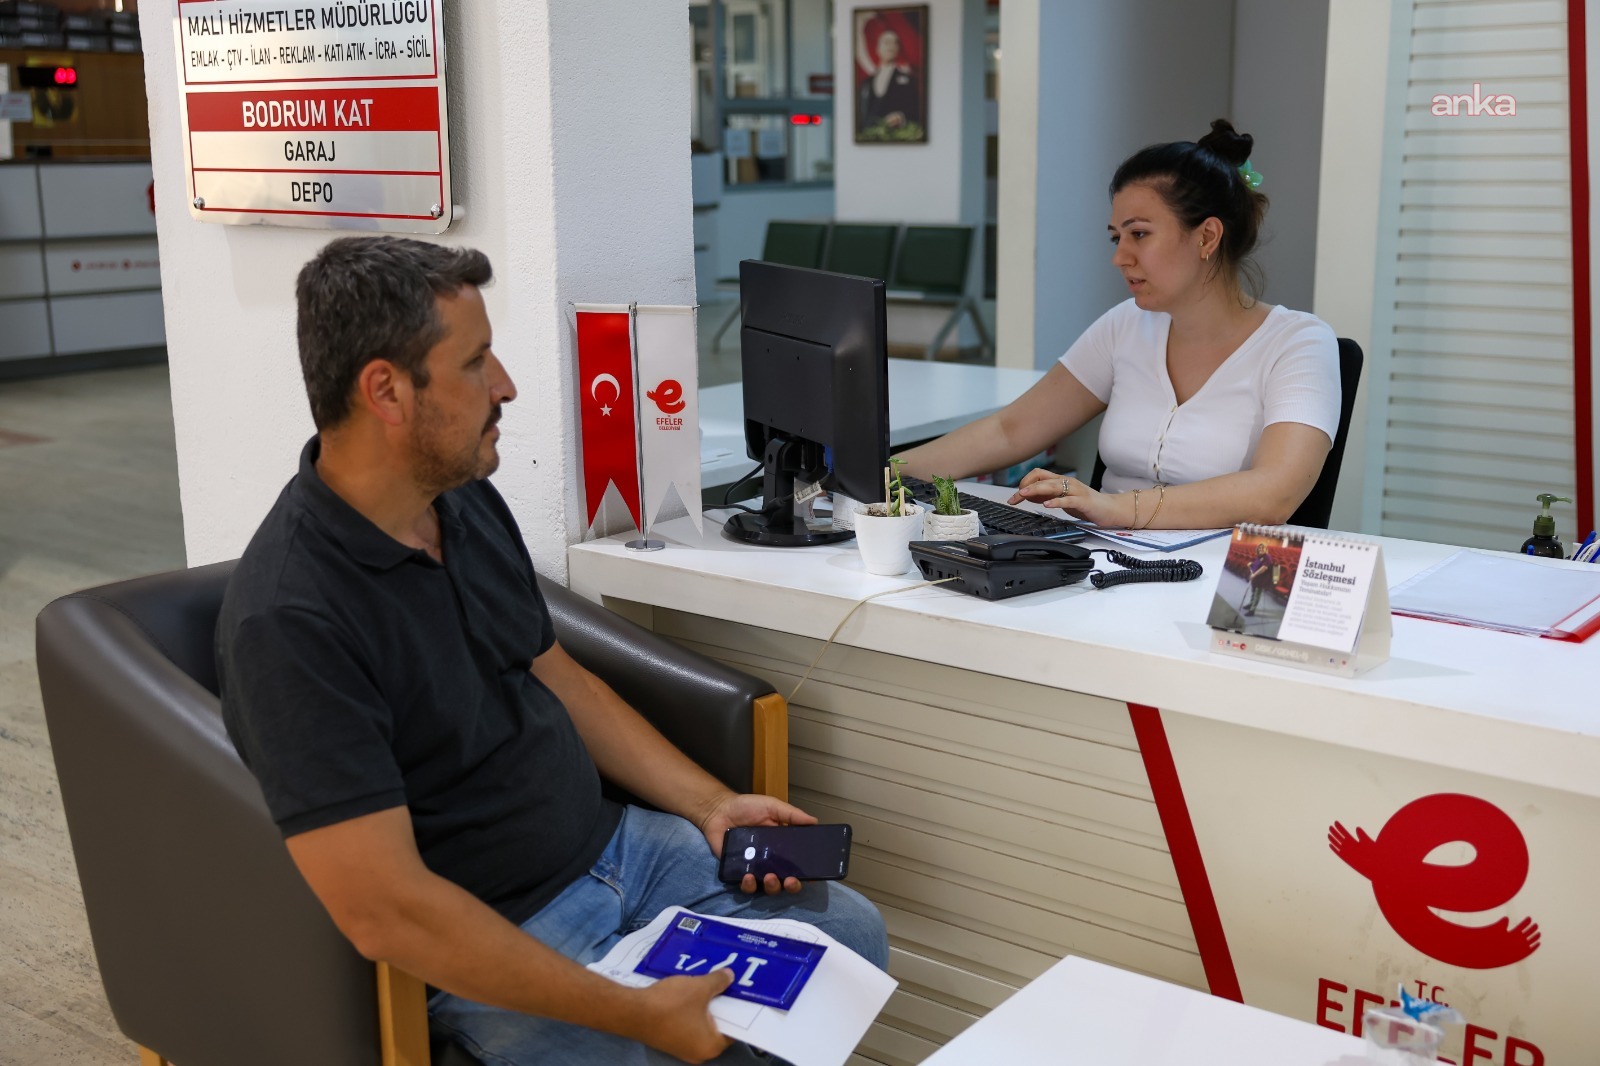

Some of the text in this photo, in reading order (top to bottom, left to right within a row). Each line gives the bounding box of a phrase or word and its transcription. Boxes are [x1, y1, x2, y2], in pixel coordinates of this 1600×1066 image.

[188, 9, 224, 36] MALİ
[229, 8, 316, 35] HİZMETLER
[191, 50, 219, 67] EMLAK
[227, 49, 242, 71] ÇTV
[250, 44, 271, 65] İLAN
[279, 45, 315, 64] REKLAM
[346, 42, 366, 61] ATIK
[375, 37, 397, 60] İCRA
[407, 34, 431, 58] SİCİL
[242, 98, 374, 128] BODRUM KAT
[284, 140, 336, 162] GARAJ
[291, 181, 333, 203] DEPO
[656, 417, 683, 426] EFELER
[1304, 556, 1346, 574] İstanbul
[1302, 568, 1357, 586] Sözleşmesi
[1414, 979, 1450, 1007] T.C.
